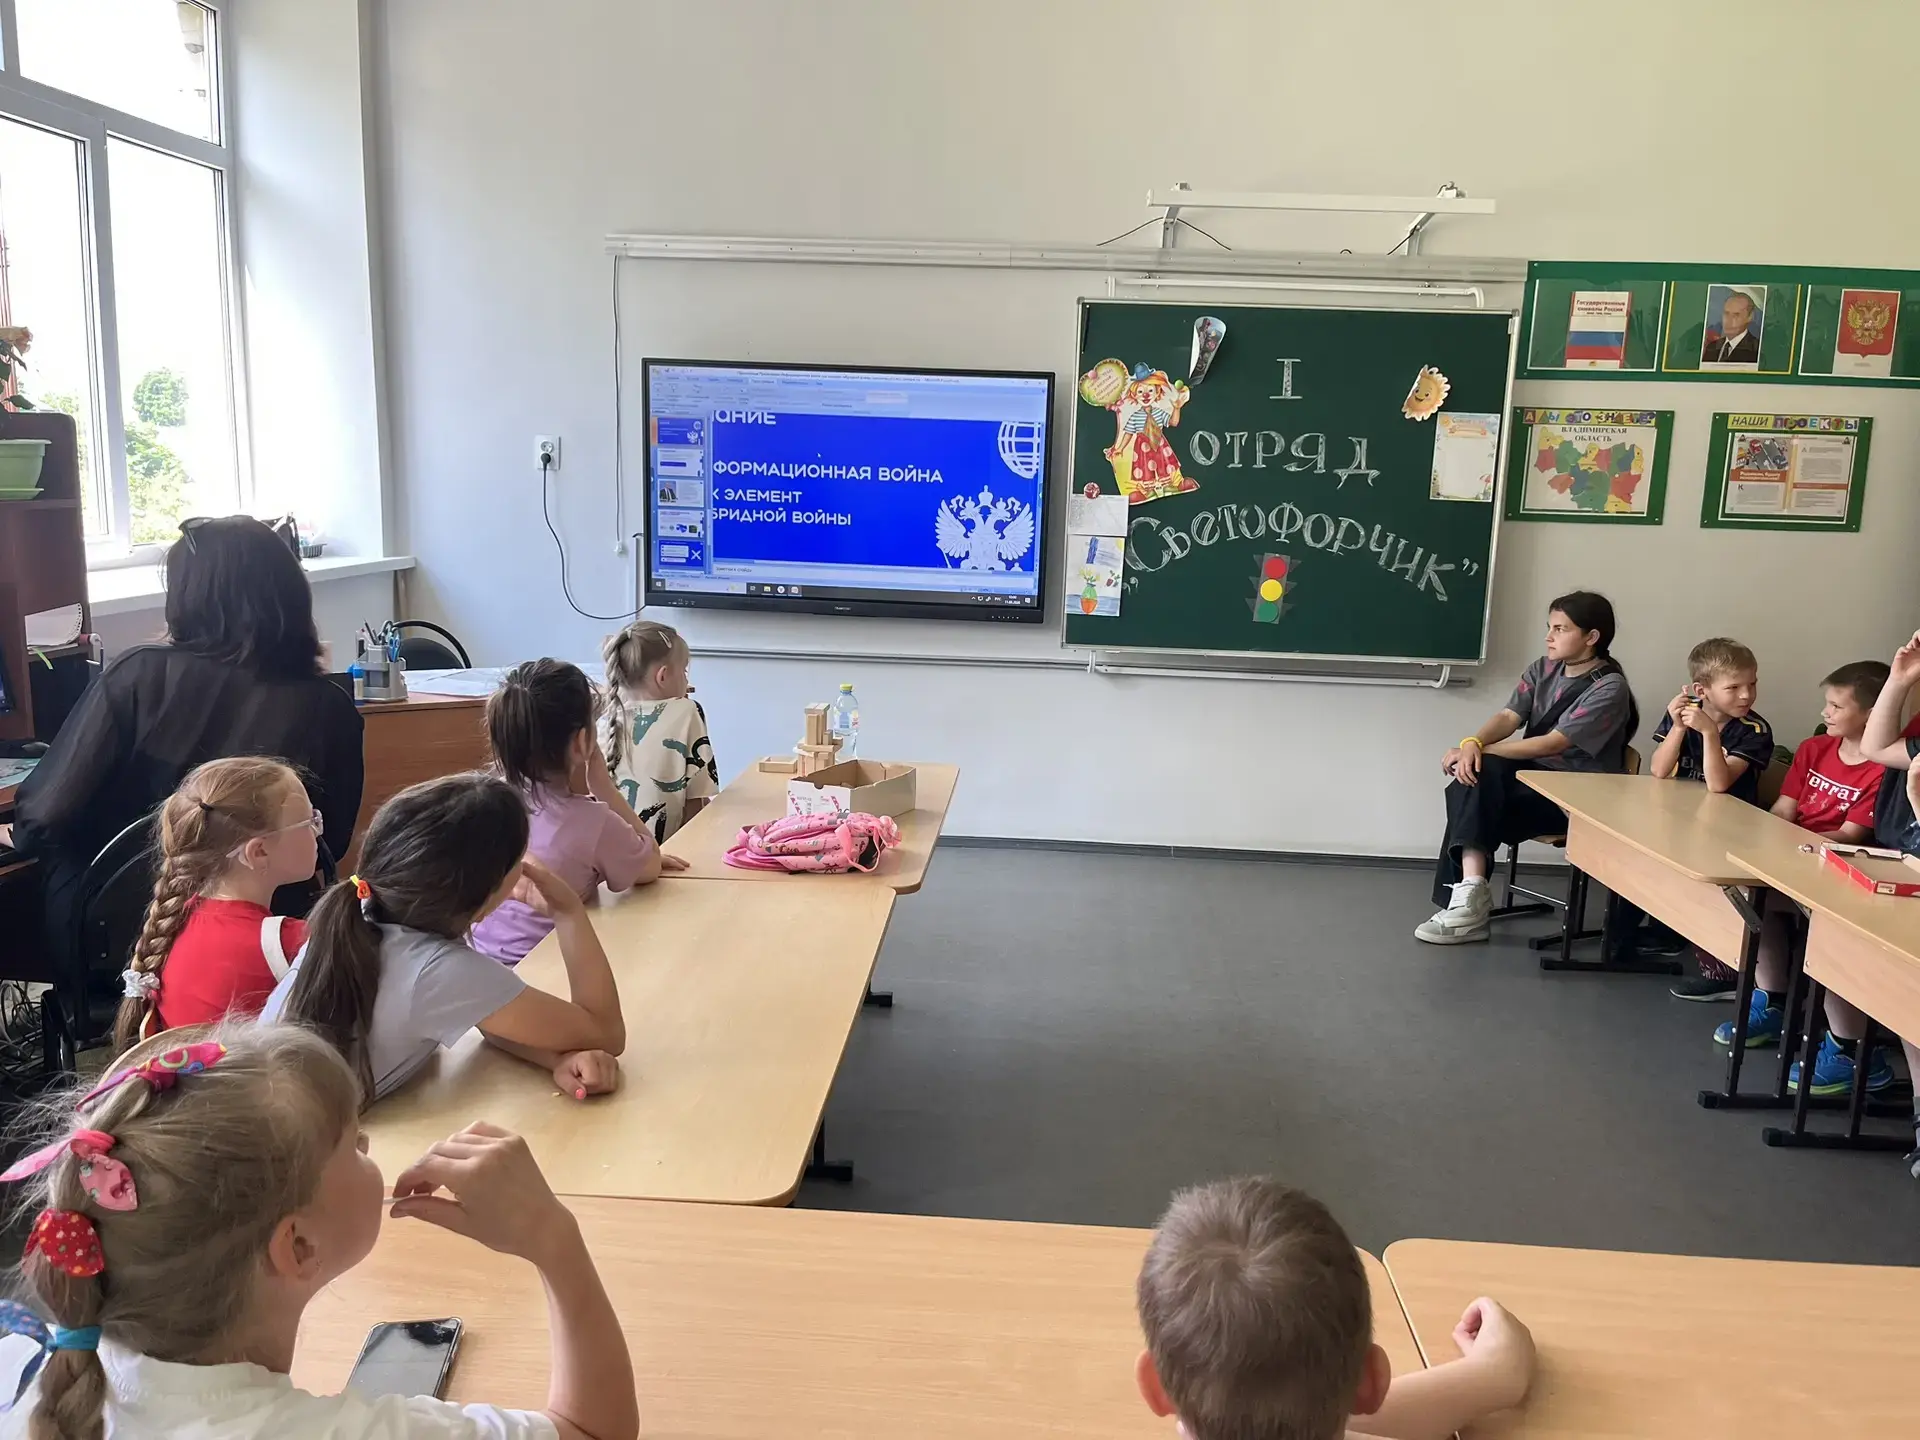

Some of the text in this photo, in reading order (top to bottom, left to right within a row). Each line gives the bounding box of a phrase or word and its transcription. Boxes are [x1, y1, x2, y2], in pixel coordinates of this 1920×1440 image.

[712, 409, 777, 425] АНИЕ
[1731, 415, 1858, 432] НАШИ ПРОЕКТЫ
[1561, 426, 1628, 434] ВЛАДИМИРСКАЯ
[1574, 434, 1612, 442] ОБЛАСТЬ
[713, 460, 944, 484] ФОРМАЦИОННАЯ ВОЙНА
[724, 488, 803, 503] ЭЛЕМЕНТ
[792, 509, 852, 526] ВОЙНЫ
